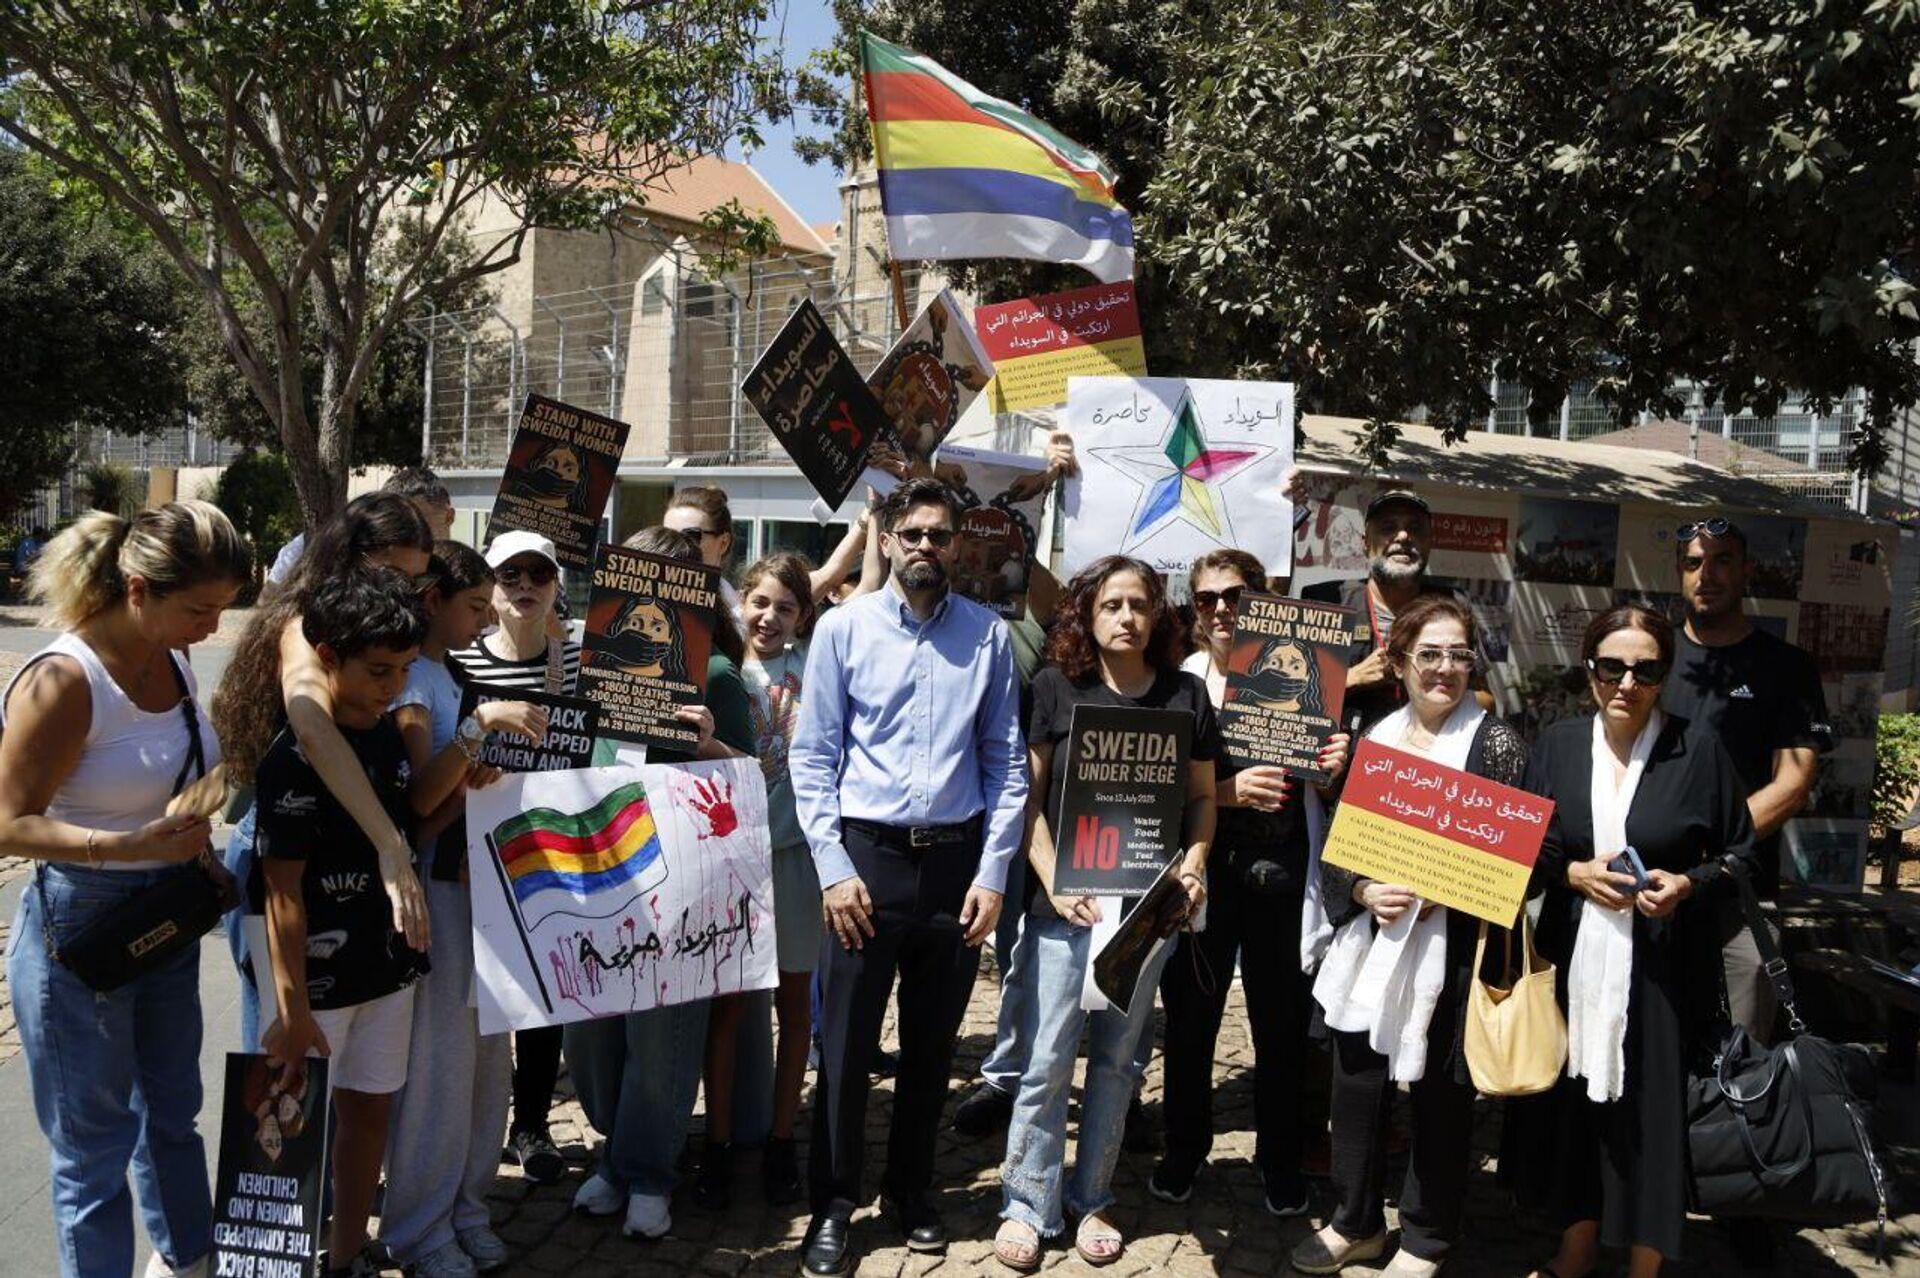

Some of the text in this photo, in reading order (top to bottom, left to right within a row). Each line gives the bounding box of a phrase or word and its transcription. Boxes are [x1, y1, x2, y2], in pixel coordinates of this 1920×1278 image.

[986, 290, 1130, 335] تحقيق دولي في الجرائم التي
[1009, 319, 1110, 349] ارتكبت في السويداء
[761, 309, 822, 404] السويداء
[775, 350, 839, 433] محاصرة
[534, 403, 618, 440] STAND WITH
[521, 415, 623, 459] SWEIDA WOMEN
[961, 519, 1011, 537] السويداء
[606, 553, 706, 589] STAND WITH
[593, 569, 716, 608] SWEIDA WOMEN
[1249, 600, 1343, 629] STAND WITH
[1237, 615, 1353, 647] SWEIDA WOMEN
[581, 666, 698, 694] HUNDREDS OF WOMEN MISSING
[598, 680, 671, 701] +1800 DEATHS
[1224, 702, 1332, 728] HUNDREDS OF WOMEN MISSING
[1270, 718, 1307, 734] DEATHS
[625, 721, 646, 734] DAYS
[647, 725, 675, 740] UNDER
[677, 730, 699, 742] SIEGE
[1272, 730, 1319, 746] DISPLACED
[1080, 730, 1178, 762] SWEIDA
[537, 753, 572, 771] AND
[1078, 762, 1177, 784] UNDER SIEGE
[1262, 752, 1281, 763] DAYS
[1283, 757, 1309, 769] UNDER
[1094, 792, 1113, 802] Since
[1124, 793, 1136, 805] July
[1364, 757, 1543, 824] تحقيق دولي في الجرائم التي
[1134, 817, 1162, 826] Water
[1379, 791, 1505, 845] ارتكبت في السويداء
[1072, 815, 1120, 871] No
[1127, 841, 1165, 850] Medicine
[1134, 828, 1160, 838] Food
[1121, 860, 1164, 871] Electricity
[1135, 851, 1154, 860] Fuel
[321, 872, 370, 894] NIKE
[237, 1172, 298, 1199] CHILDREN
[228, 1197, 303, 1227] WOMEN AND
[214, 1222, 311, 1257] THE KIDNAPPED
[217, 1250, 302, 1278] BRING BACK
